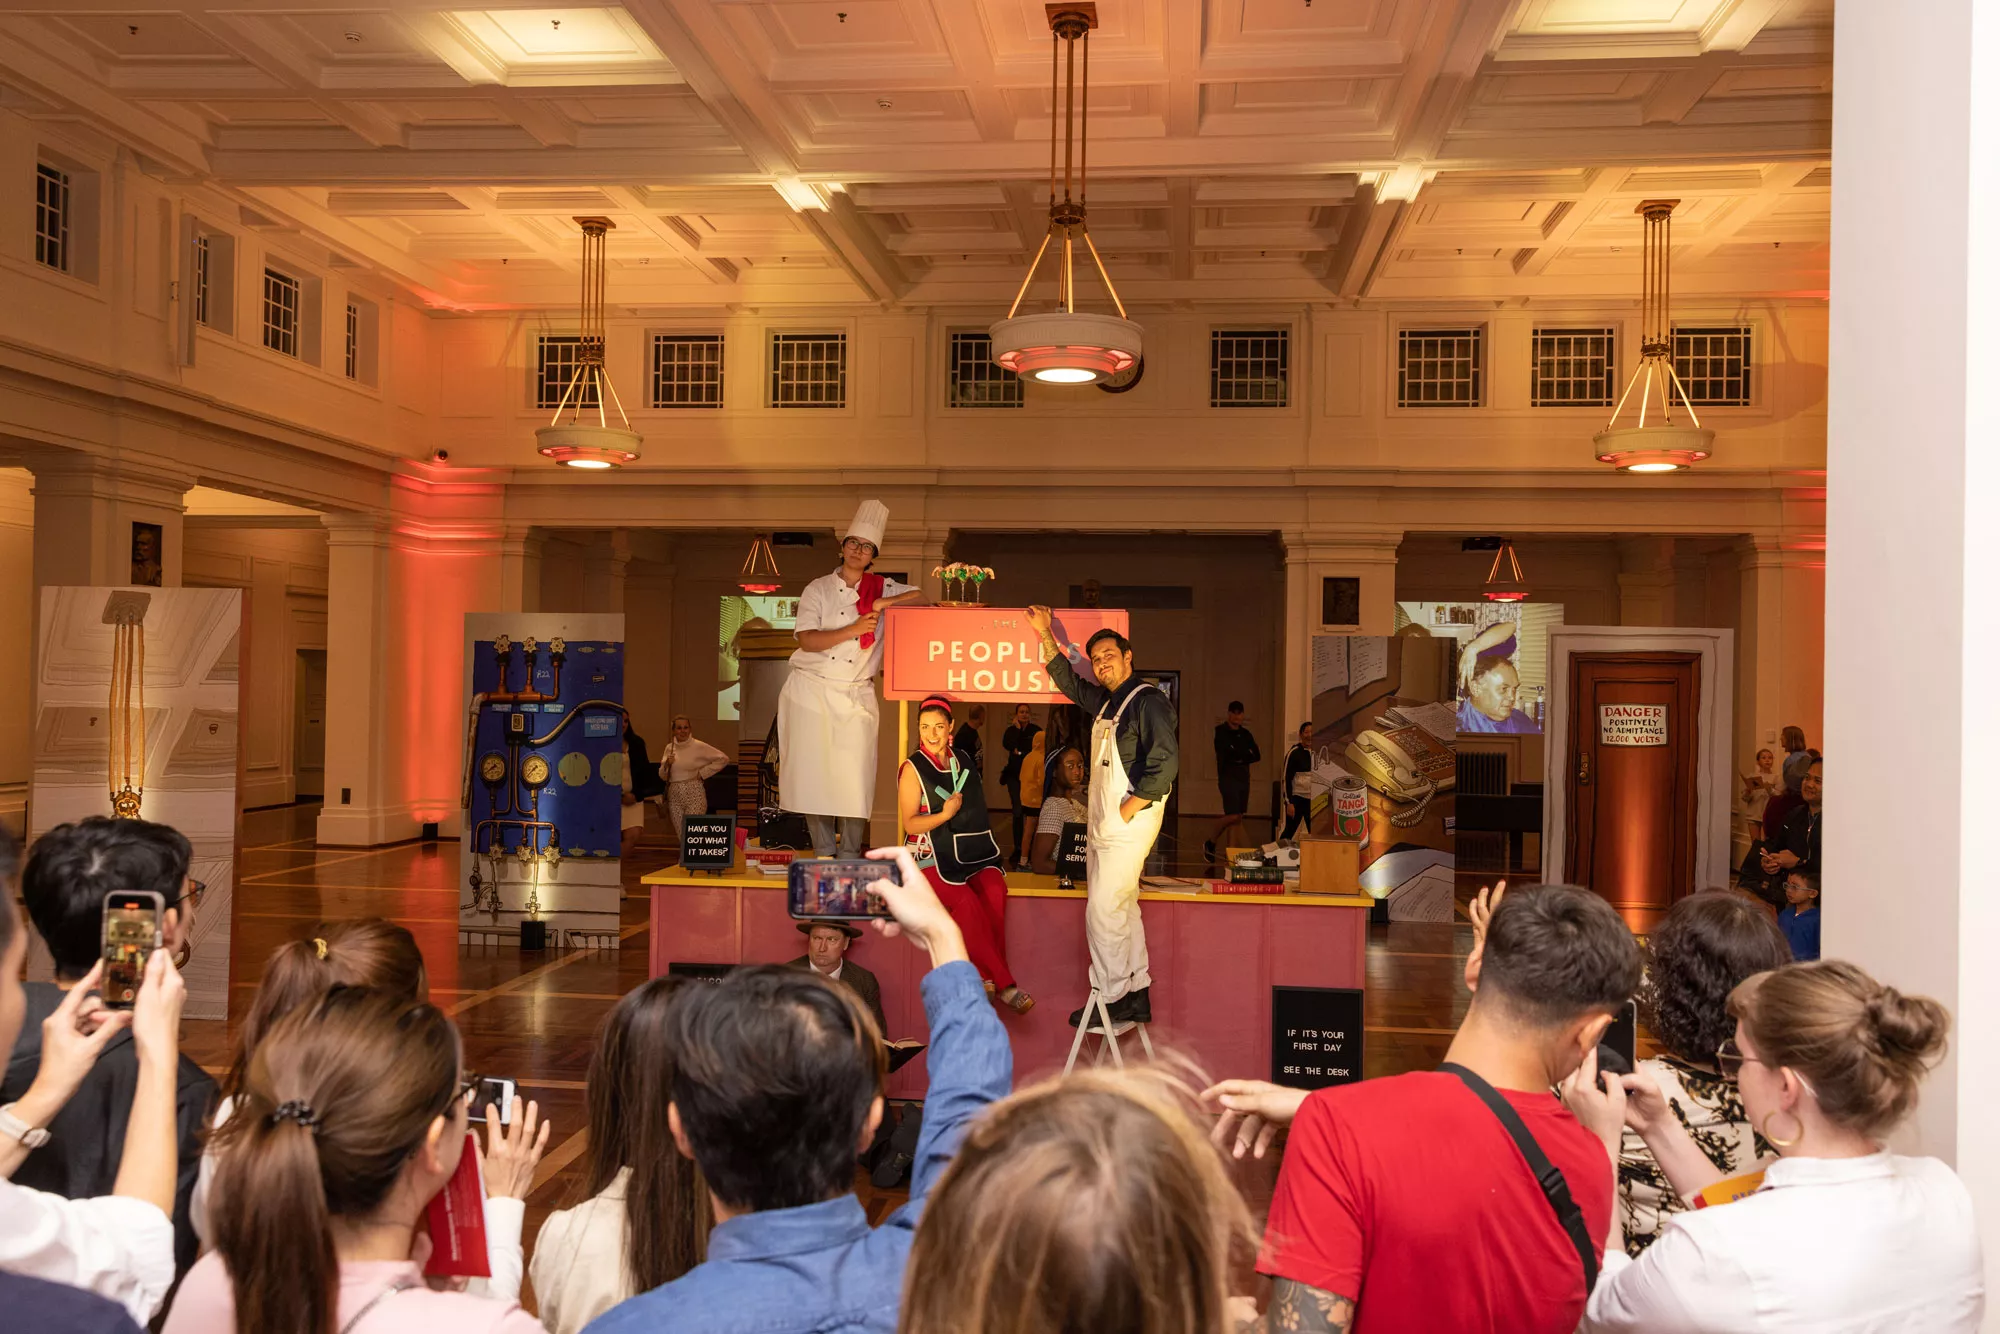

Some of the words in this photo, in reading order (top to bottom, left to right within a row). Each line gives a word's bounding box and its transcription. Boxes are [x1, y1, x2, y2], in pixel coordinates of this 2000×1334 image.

[1604, 706, 1662, 717] DANGER
[1609, 718, 1660, 727] POSITIVELY
[1616, 727, 1665, 735] ADMITTANCE
[1632, 735, 1661, 744] VOLTS
[1337, 797, 1365, 810] TANGO
[687, 825, 708, 833] HAVE
[710, 825, 727, 833] YOU
[687, 836, 703, 844] GOT
[1074, 833, 1087, 841] RIN
[688, 848, 696, 856] IT
[698, 847, 729, 857] TAKES?
[1287, 1029, 1297, 1037] IF
[1302, 1029, 1318, 1038] IT'S
[1321, 1030, 1344, 1039] YOUR
[1293, 1042, 1318, 1051] FIRST
[1323, 1043, 1342, 1052] DAY
[1283, 1065, 1300, 1074] SEE
[1304, 1066, 1321, 1075] THE
[1327, 1068, 1349, 1076] DESK
